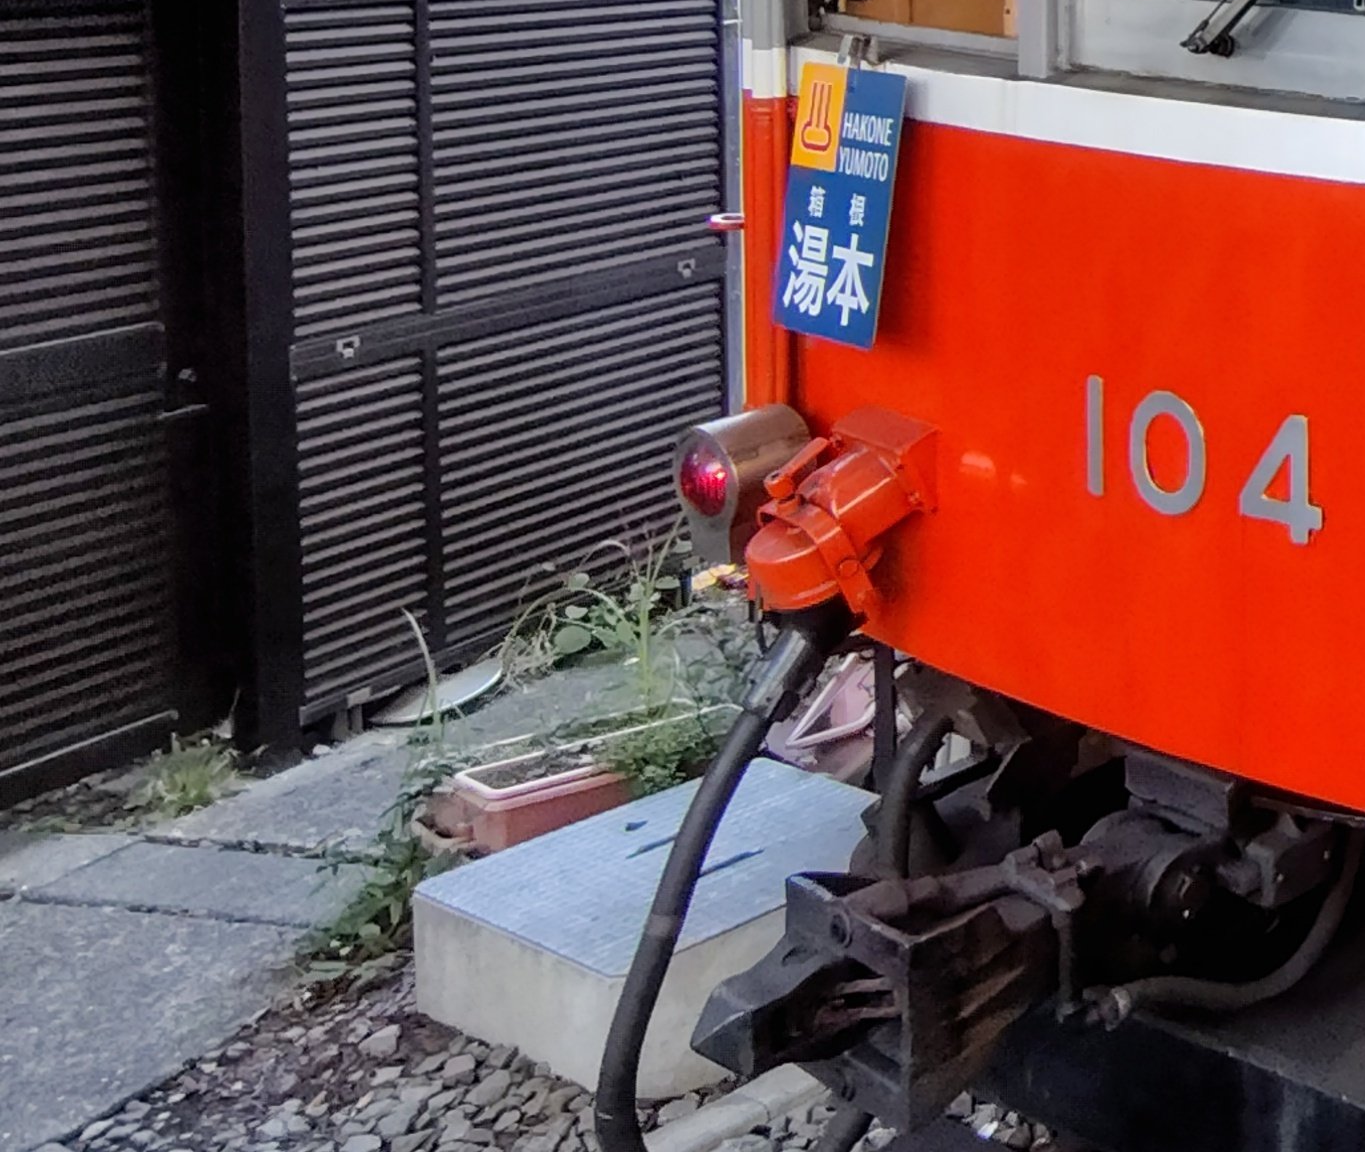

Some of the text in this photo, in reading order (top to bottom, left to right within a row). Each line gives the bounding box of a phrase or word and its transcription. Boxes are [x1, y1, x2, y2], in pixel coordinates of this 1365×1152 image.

[842, 112, 895, 147] HAKONE
[838, 146, 888, 182] YUMOTO
[809, 185, 867, 227] 箱根
[782, 220, 874, 327] 湯本
[1085, 374, 1324, 545] 104
